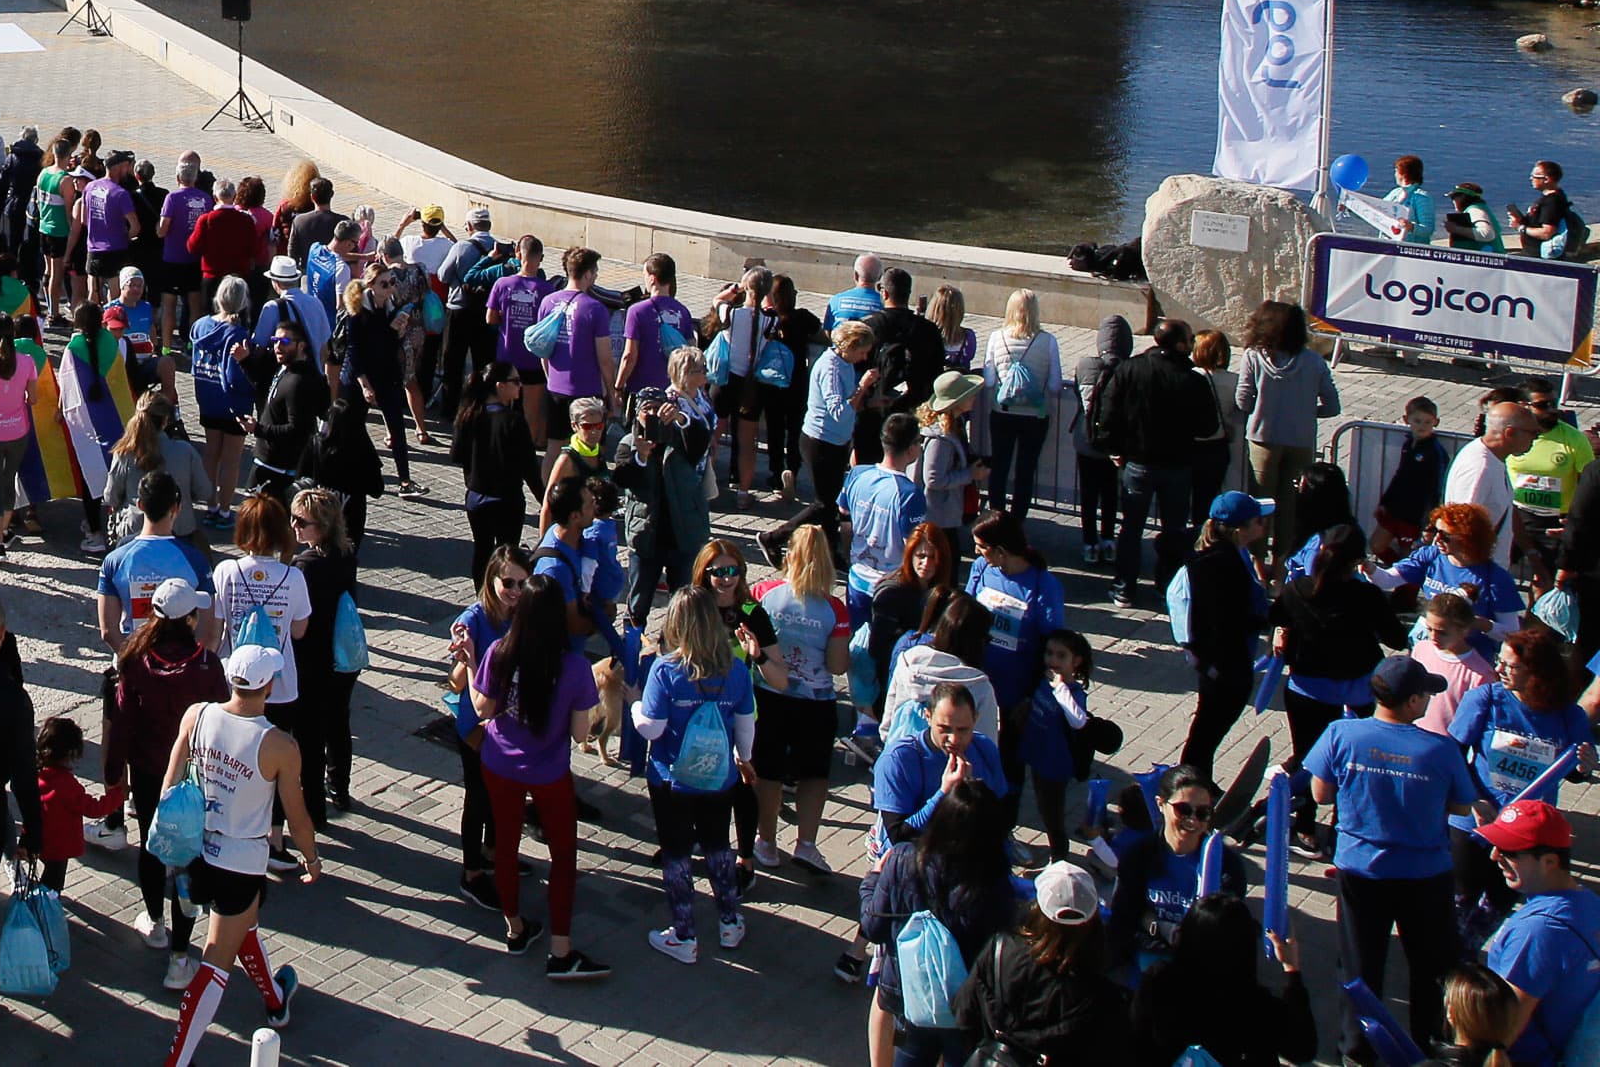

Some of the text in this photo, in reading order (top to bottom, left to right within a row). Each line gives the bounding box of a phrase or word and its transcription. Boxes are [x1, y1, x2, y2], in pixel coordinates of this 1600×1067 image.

[1433, 250, 1461, 261] CYPRUS
[1365, 273, 1536, 321] Logicom
[1445, 337, 1474, 348] CYPRUS
[1523, 491, 1552, 504] 1070
[771, 610, 822, 628] Logicom
[223, 753, 254, 782] BARTKA
[1496, 756, 1539, 781] 4456
